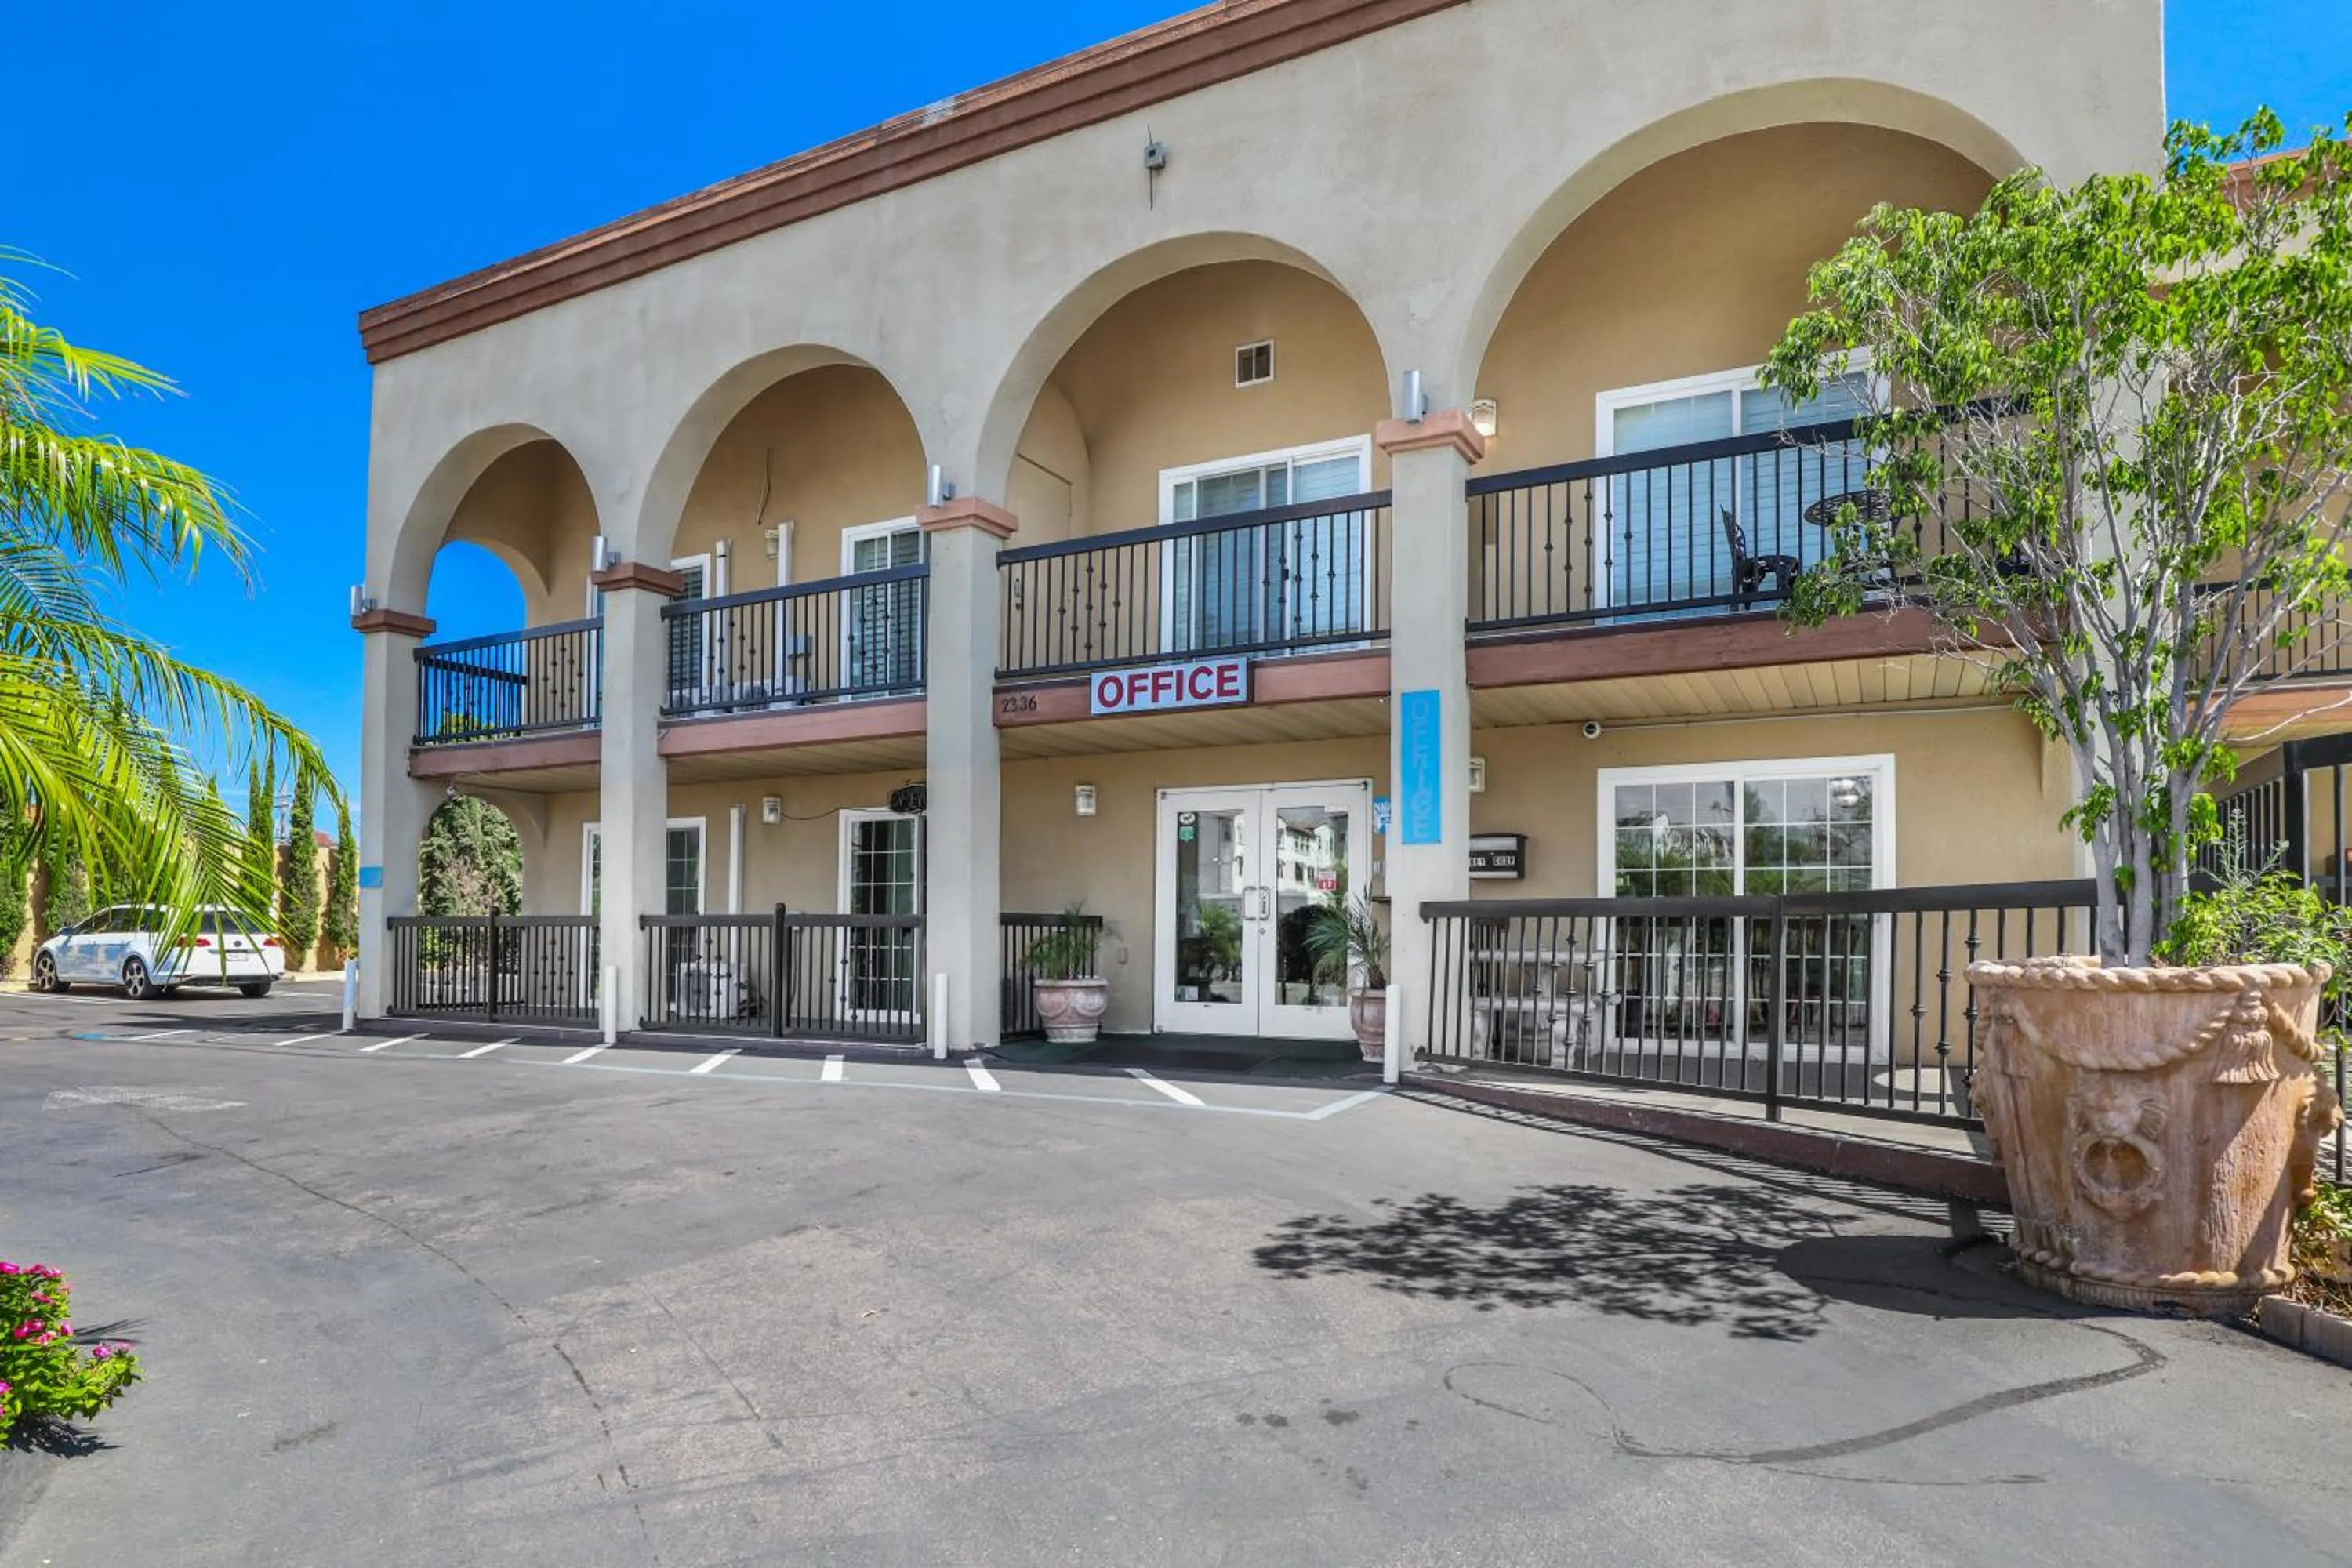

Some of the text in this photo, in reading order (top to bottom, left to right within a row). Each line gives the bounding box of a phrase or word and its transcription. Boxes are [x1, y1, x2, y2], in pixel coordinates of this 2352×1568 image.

[1000, 695, 1037, 714] 2336
[1098, 664, 1239, 708] OFFICE
[1410, 697, 1432, 840] OFFICE
